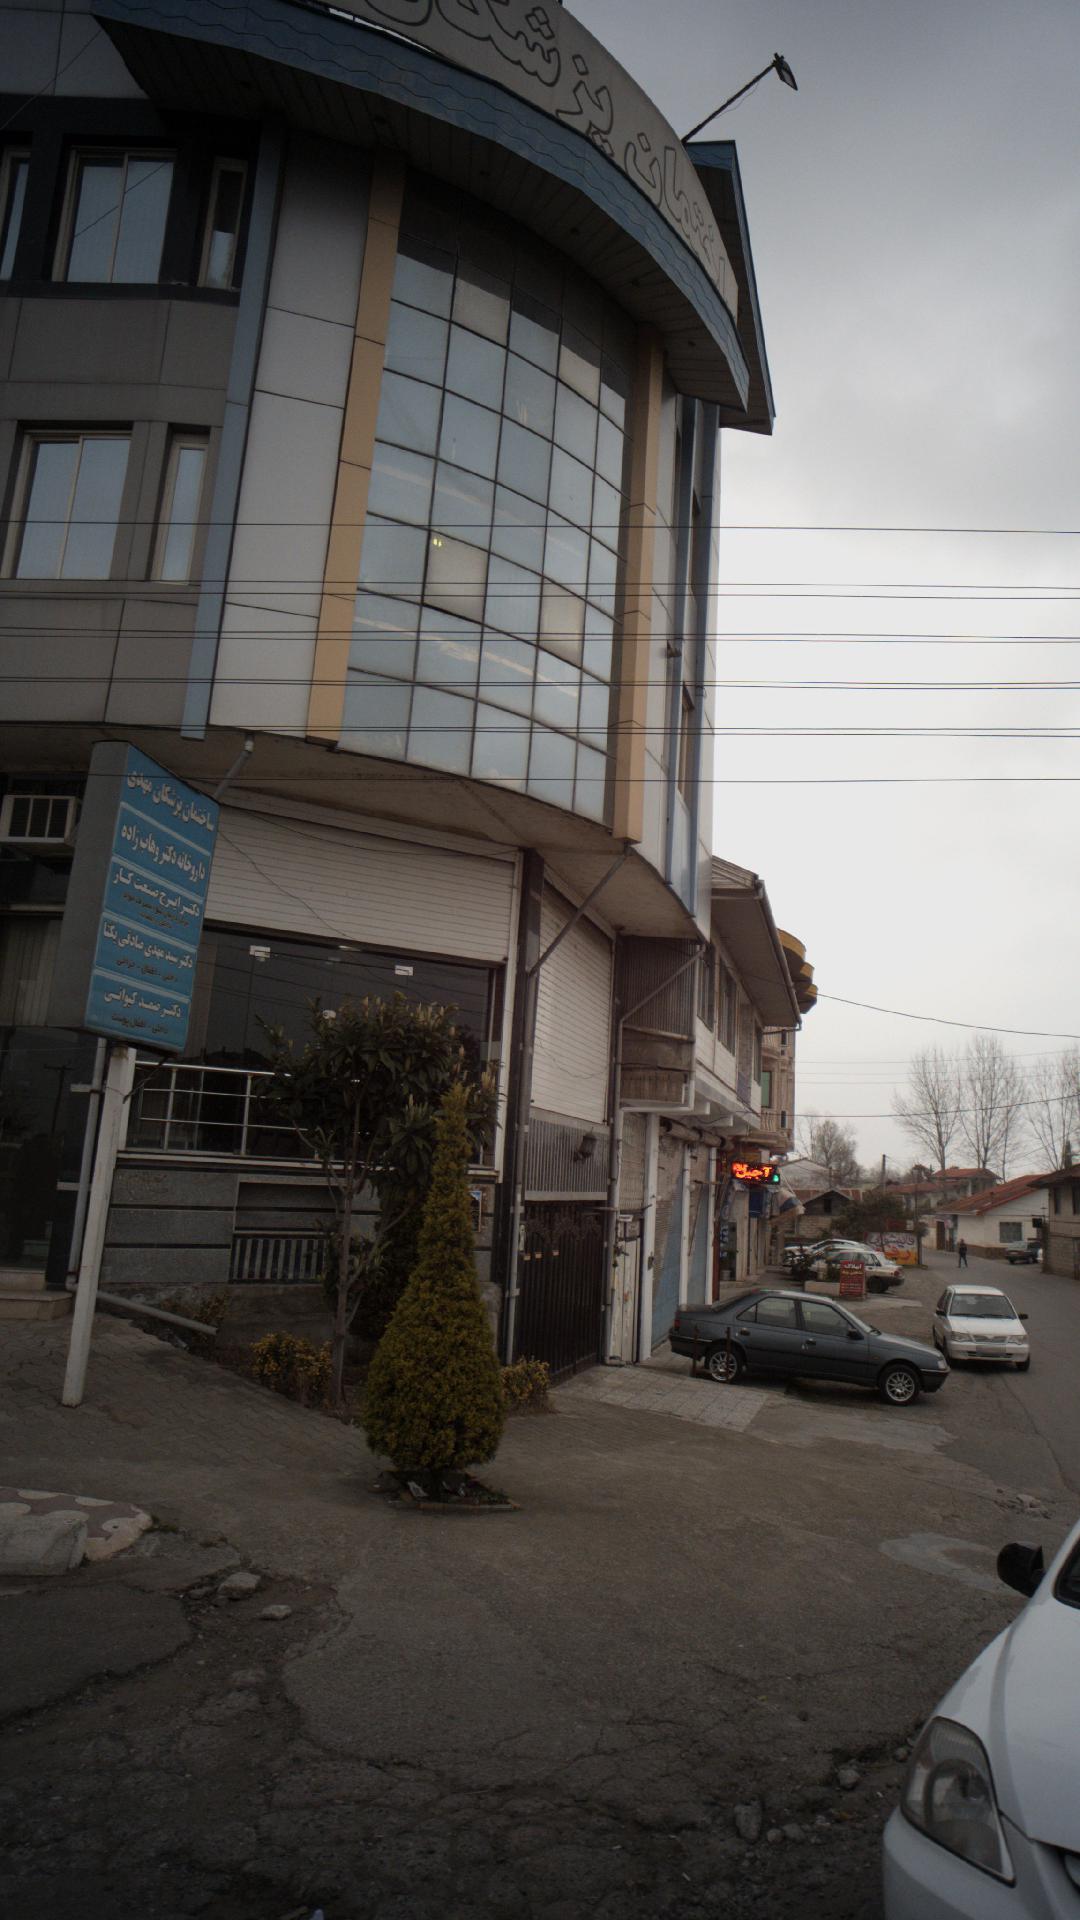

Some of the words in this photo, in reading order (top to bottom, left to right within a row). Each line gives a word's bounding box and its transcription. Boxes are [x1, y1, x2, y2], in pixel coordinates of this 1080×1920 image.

[152, 783, 184, 817] پزشکان
[182, 800, 215, 832] ساختمان
[158, 845, 177, 865] دکتر
[112, 867, 134, 885] کار
[159, 891, 181, 910] ایرج
[179, 902, 199, 917] دکتر
[118, 930, 144, 950] صادقی
[143, 944, 165, 960] مهدی
[165, 951, 177, 964] سید
[176, 954, 193, 969] دکتر
[138, 997, 161, 1011] صمد
[160, 1003, 181, 1018] دکتر
